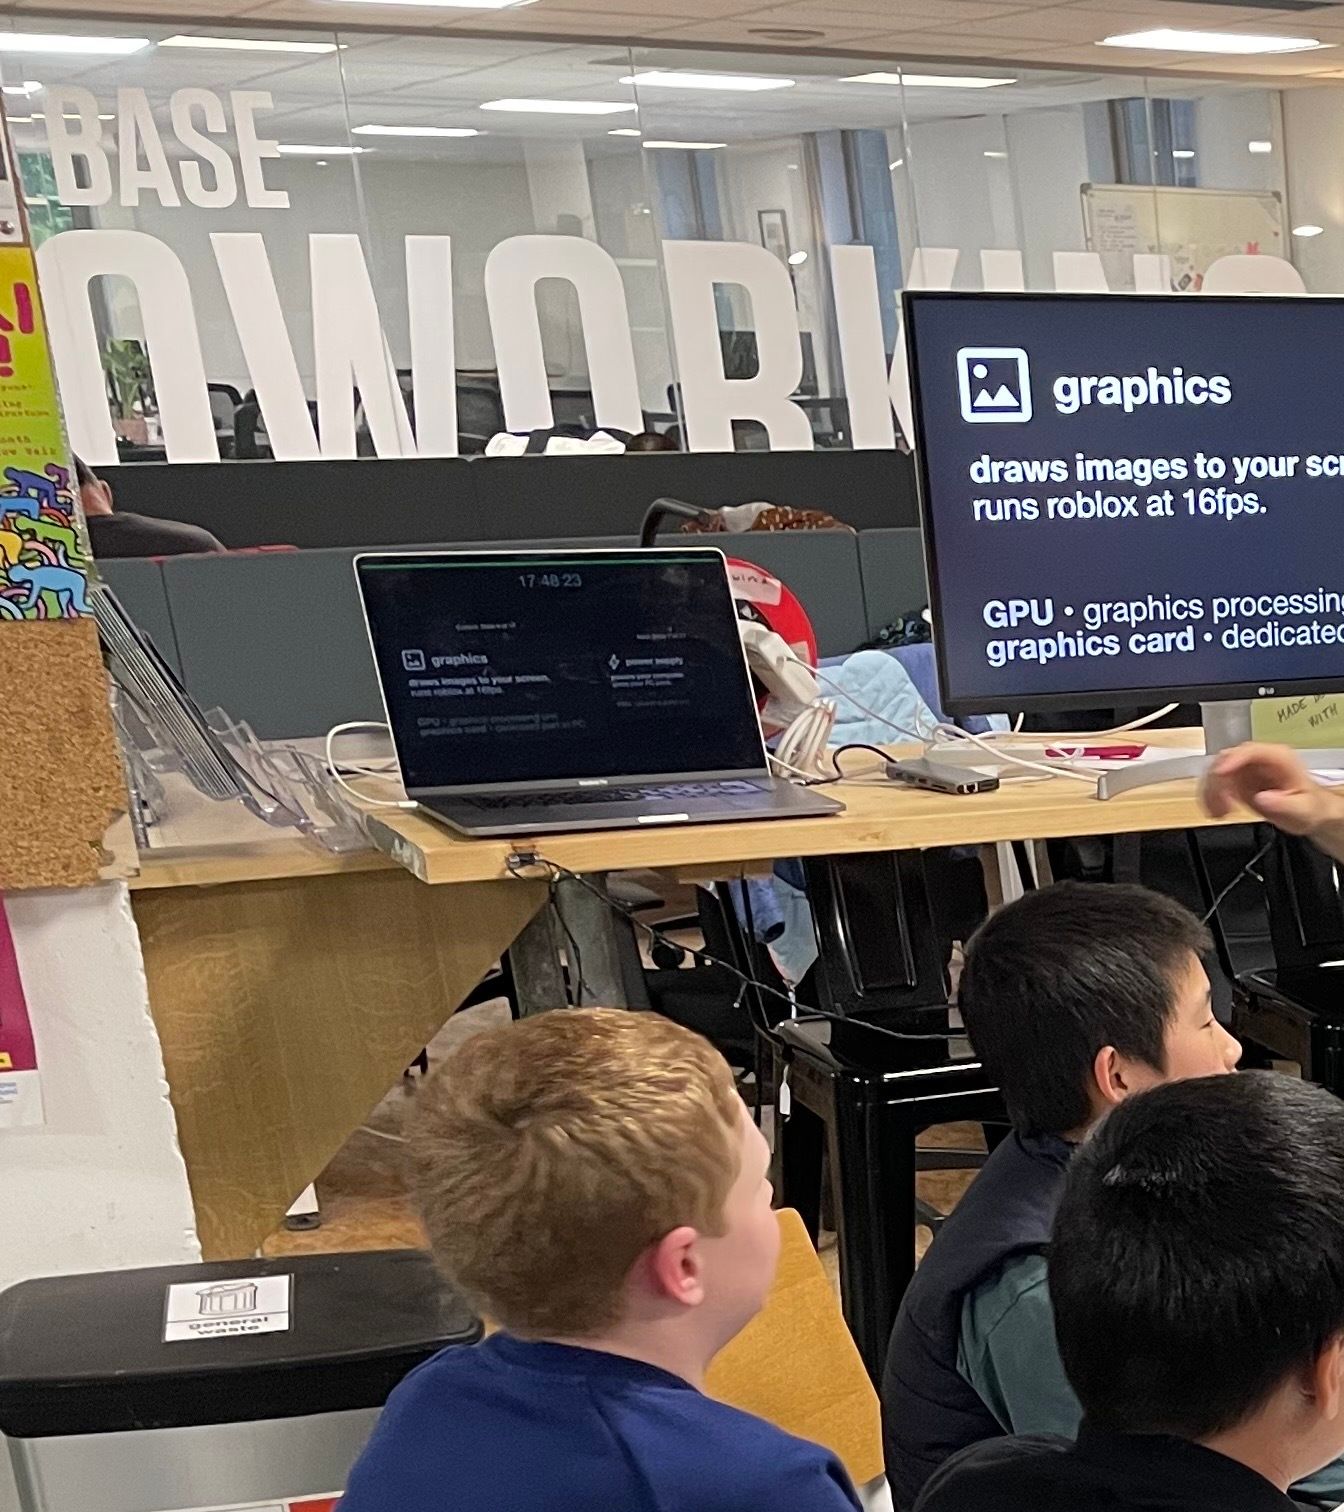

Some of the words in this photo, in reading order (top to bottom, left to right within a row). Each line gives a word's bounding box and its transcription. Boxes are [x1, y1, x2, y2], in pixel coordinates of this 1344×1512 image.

[43, 87, 291, 209] BASE
[1053, 367, 1232, 414] graphics
[969, 454, 1069, 484] draws
[1075, 451, 1188, 487] images
[1194, 450, 1226, 479] to
[1232, 454, 1300, 485] your
[972, 495, 1040, 522] runs
[1046, 489, 1140, 520] roblox
[1146, 489, 1175, 517] at
[1182, 486, 1268, 522] 16fps.
[982, 597, 1055, 629] GPU
[1082, 593, 1204, 628] graphics
[431, 652, 489, 668] graphics
[985, 630, 1121, 668] graphics
[1127, 623, 1196, 654] card
[1276, 696, 1308, 724] MADE
[1307, 702, 1339, 728] WITH
